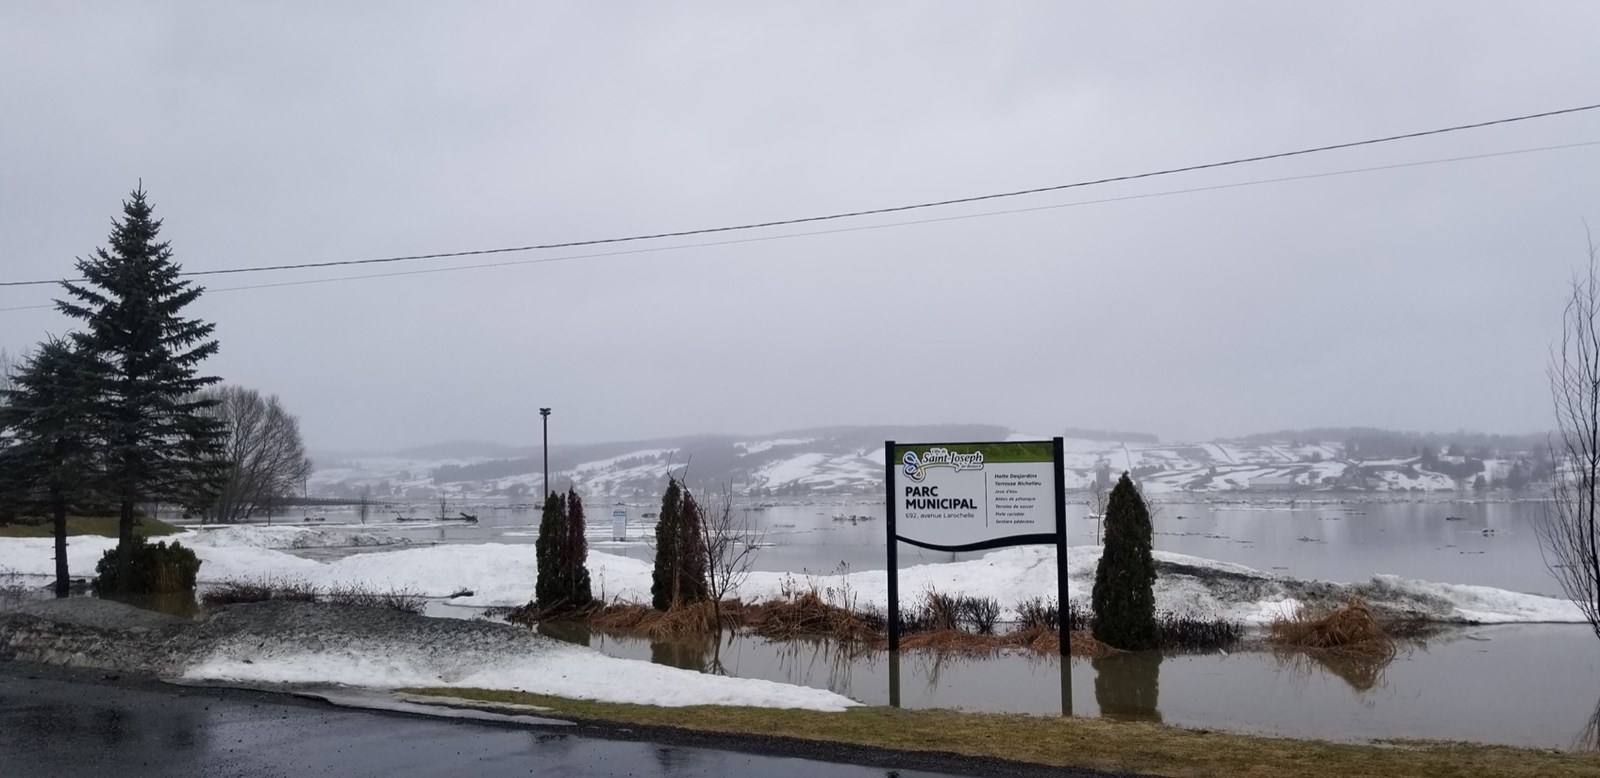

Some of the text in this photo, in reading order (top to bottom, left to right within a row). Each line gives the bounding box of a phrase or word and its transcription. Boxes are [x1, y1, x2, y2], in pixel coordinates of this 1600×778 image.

[923, 452, 982, 464] Saint-Joseph
[905, 486, 938, 497] PARC
[905, 498, 978, 510] MUNICIPAL
